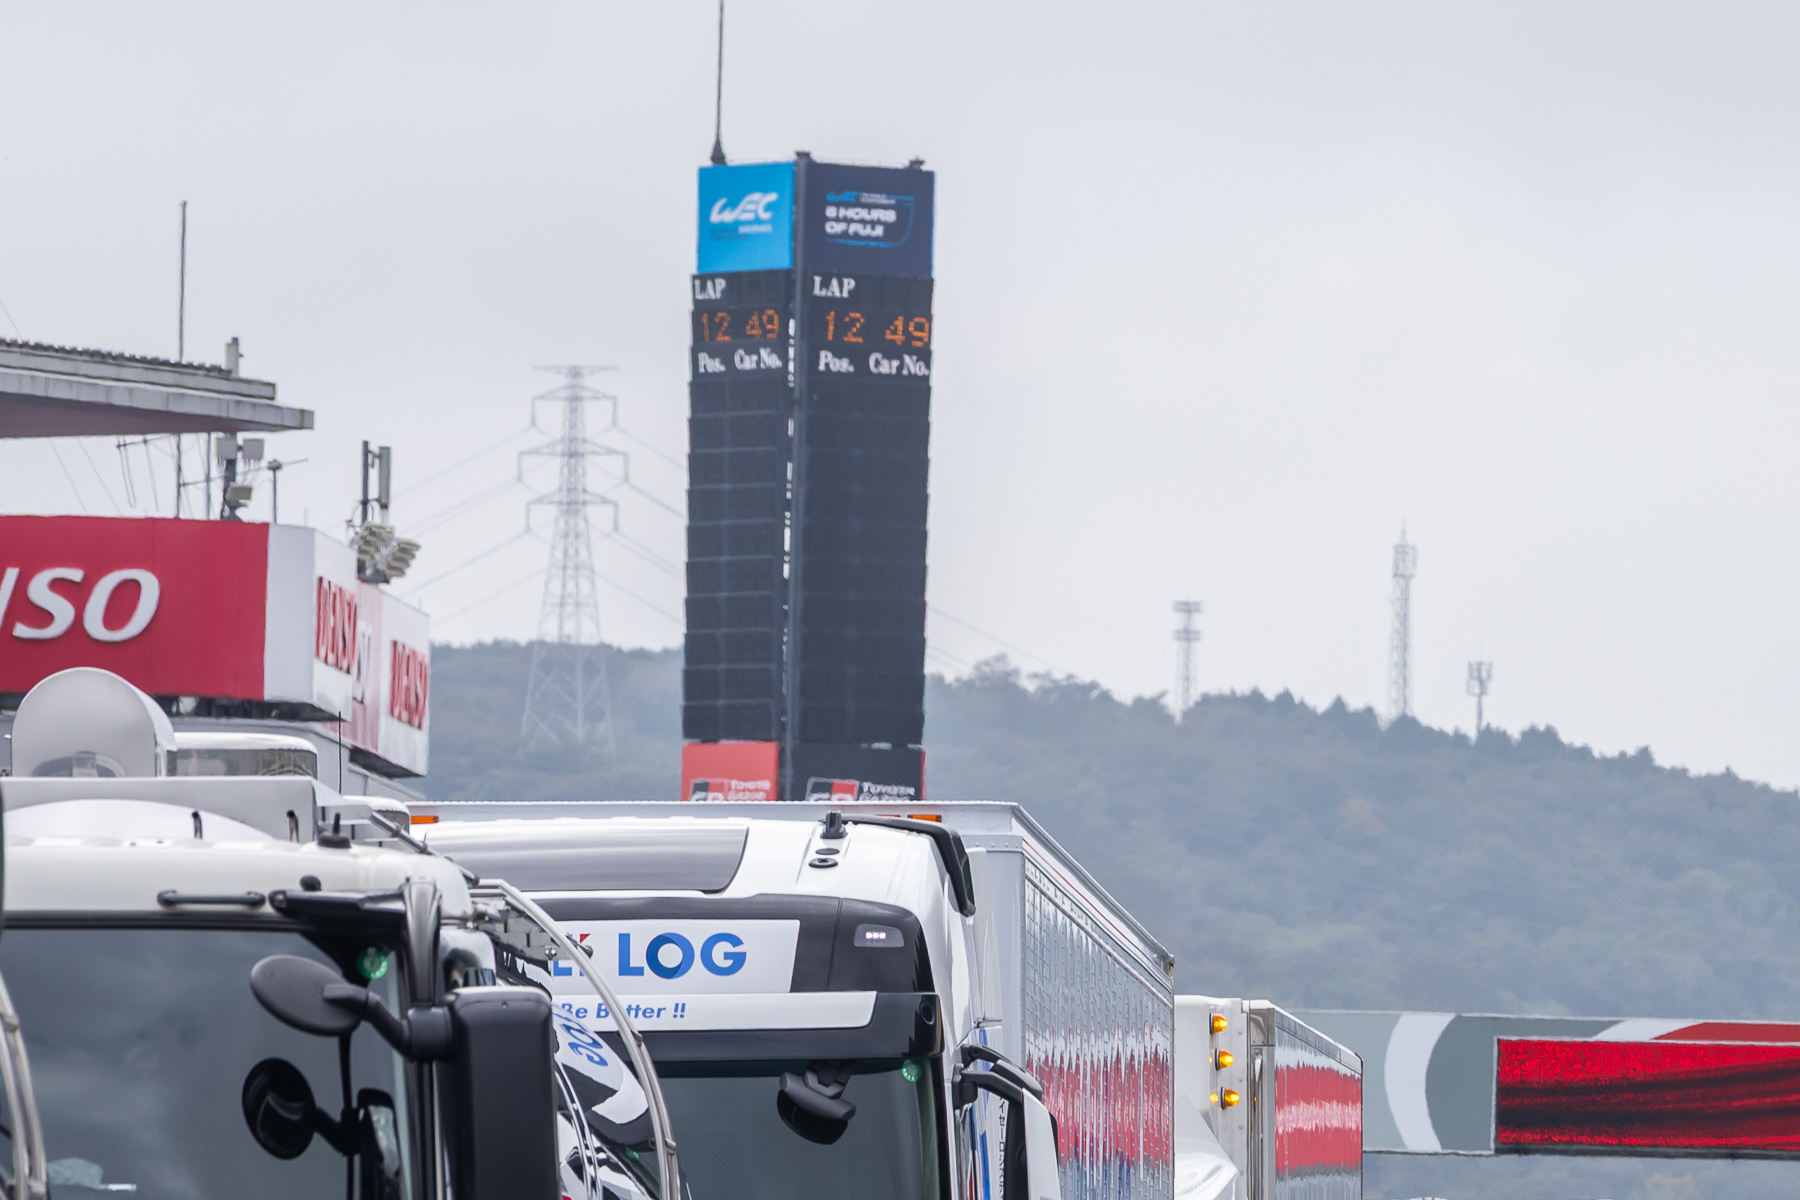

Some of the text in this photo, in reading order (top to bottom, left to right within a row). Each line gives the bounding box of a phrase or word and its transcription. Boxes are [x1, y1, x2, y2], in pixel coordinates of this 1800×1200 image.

[709, 191, 779, 224] WEC
[825, 205, 897, 223] 6 HOURS
[824, 222, 885, 237] OF FUJI
[694, 278, 727, 300] LAP
[812, 275, 856, 298] LAP
[701, 308, 780, 343] 12 49
[825, 310, 930, 348] 12 49
[697, 347, 783, 373] Pos. Car No.
[818, 350, 930, 377] Pos. Car No.
[618, 932, 747, 980] LOG
[596, 1002, 666, 1019] Btter
